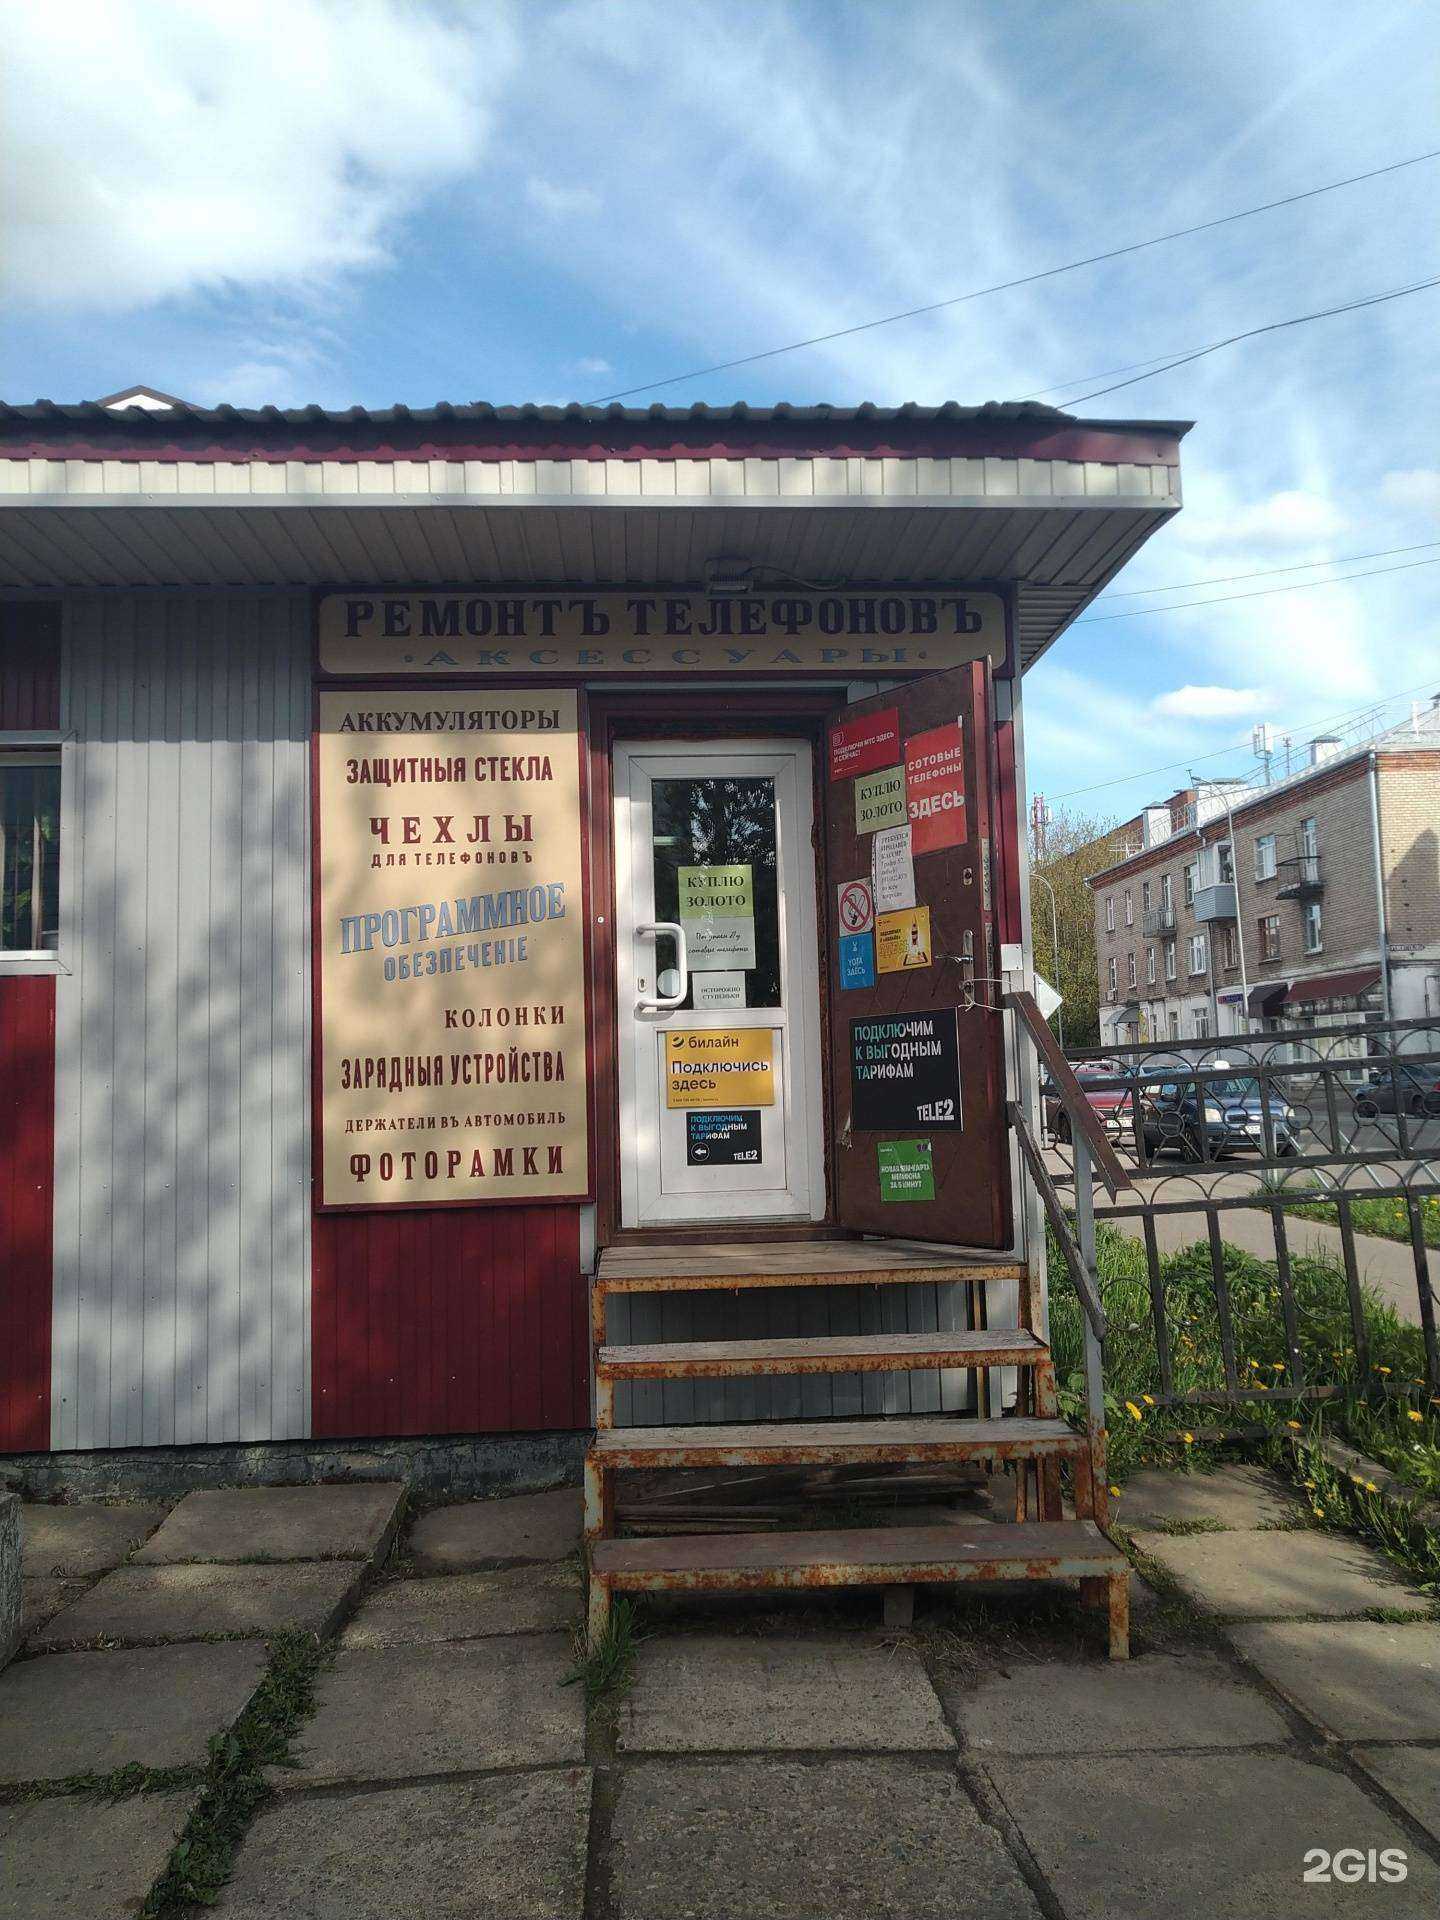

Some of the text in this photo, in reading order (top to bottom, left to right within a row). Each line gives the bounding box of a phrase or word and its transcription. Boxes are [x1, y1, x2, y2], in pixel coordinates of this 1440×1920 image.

[344, 598, 983, 638] РЕМОНТЪ ТЕЛЕФОНОВЪ
[423, 647, 912, 667] АКСЕССУАРЫ
[339, 709, 561, 733] АККУМУЛЯТОРЫ
[908, 747, 962, 772] СОТОВЫЕ
[346, 756, 554, 787] ЗАЩИТНЫЯ СТЕКЛА
[908, 762, 962, 785] ТЕЛЕФОНЫ
[860, 779, 901, 801] КУПЛЮ
[860, 801, 903, 822] ЗОЛОТО
[908, 790, 966, 820] ЗДЕСЬ
[369, 815, 534, 844] ЧЕХЛЫ
[371, 851, 533, 869] ДЛЯ ТЕЛЕФОНОВЪ
[687, 875, 744, 888] КУПЛЮ
[687, 895, 746, 908] ЗОЛОТО
[340, 882, 567, 954] ПРОГРАММНОЕ
[384, 936, 529, 982] ОБЕЗПЕЧЕНІЕ
[445, 1005, 566, 1029] КОЛОНКИ
[854, 1020, 934, 1042] ПОДКЛЮЧИМ
[688, 1036, 739, 1049] билайн
[855, 1041, 942, 1061] К ВЫГОДНЫМ
[341, 1046, 566, 1093] ЗАРЯДНЫЯ УСТРОЙСТВА
[672, 1060, 769, 1075] Подключись
[855, 1063, 915, 1080] ТАРИФАМ
[672, 1079, 717, 1092] здесь
[690, 1115, 743, 1123] ПОДКЛЮЧИМ
[917, 1099, 955, 1121] TELE2
[345, 1112, 566, 1134] ДЕРЖАТЕЛИ ВЪ АВТОМОБИЛЬ
[690, 1123, 748, 1132] К ВЫГОДНЫМ
[690, 1132, 730, 1140] ТАРИФАМ
[350, 1146, 564, 1183] ФОТОРАМКИ
[734, 1149, 758, 1161] TELE2
